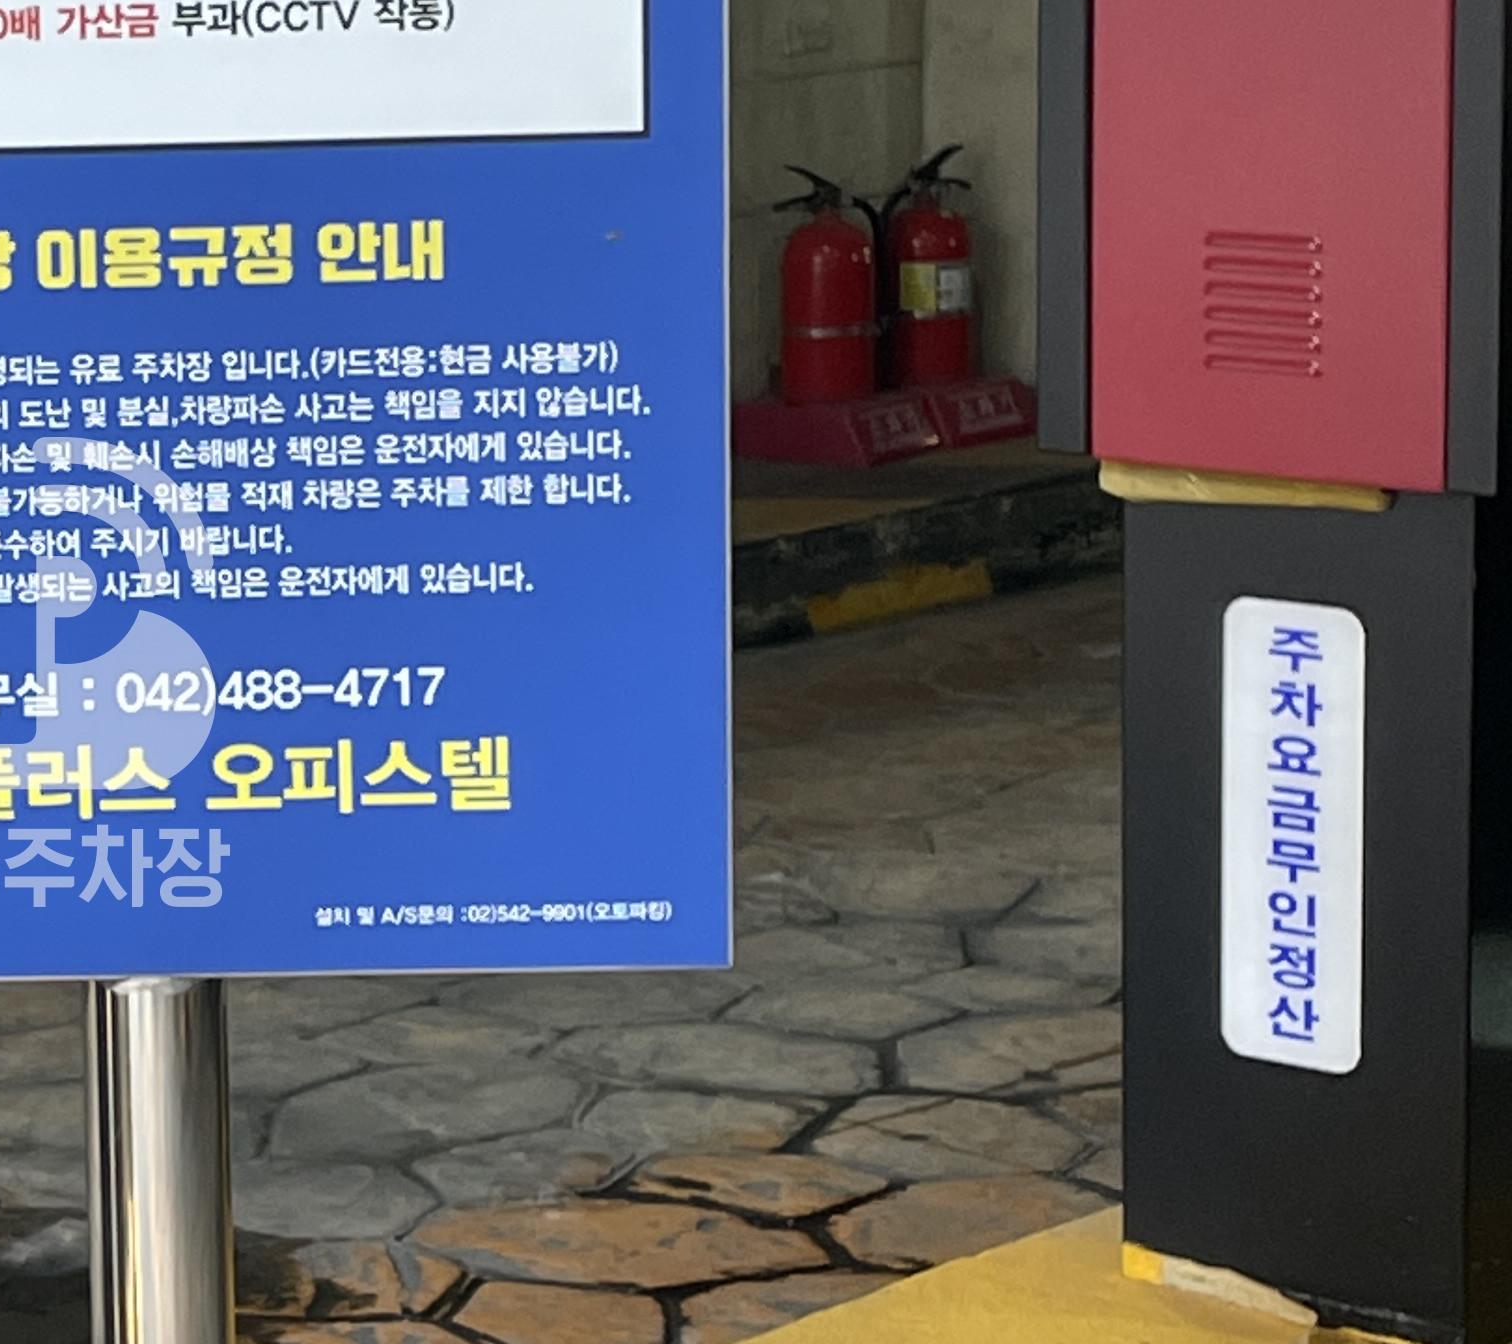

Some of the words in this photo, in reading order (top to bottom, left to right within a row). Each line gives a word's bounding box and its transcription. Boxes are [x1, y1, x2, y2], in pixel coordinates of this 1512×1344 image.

[59, 4, 158, 38] 가산금
[173, 0, 359, 36] 부과(CCTV
[37, 224, 292, 288] 이용규정
[318, 220, 443, 282] 안내
[71, 355, 122, 384] 유료
[133, 352, 212, 383] 주차장
[503, 341, 617, 373] 사용불가)
[19, 399, 71, 428] 도난
[82, 398, 105, 427] 및
[295, 392, 373, 422] 사고는
[386, 389, 462, 420] 책임을
[475, 388, 525, 418] 지지
[537, 385, 649, 417] 않습니다.
[47, 442, 70, 470] 및
[173, 439, 275, 468] 손해배상
[287, 435, 364, 465] 책임은
[375, 432, 505, 463] 운전자에게
[517, 430, 630, 460] 있습니다.
[155, 484, 229, 512] 위험물
[243, 482, 291, 509] 적재
[304, 479, 381, 509] 차량은
[391, 476, 469, 507] 주차를
[481, 475, 532, 504] 제한
[544, 474, 630, 504] 합니다.
[92, 528, 167, 556] 주시기
[180, 526, 290, 555] 바랍니다.
[104, 571, 178, 599] 사고의
[193, 569, 268, 597] 책임은
[279, 565, 408, 596] 운전자에게
[421, 562, 533, 593] 있습니다.
[117, 667, 444, 715] 042)488-4717
[206, 734, 512, 812] 오피스텔
[1268, 629, 1322, 1041] 주차요금무인정산
[357, 907, 373, 924] 및
